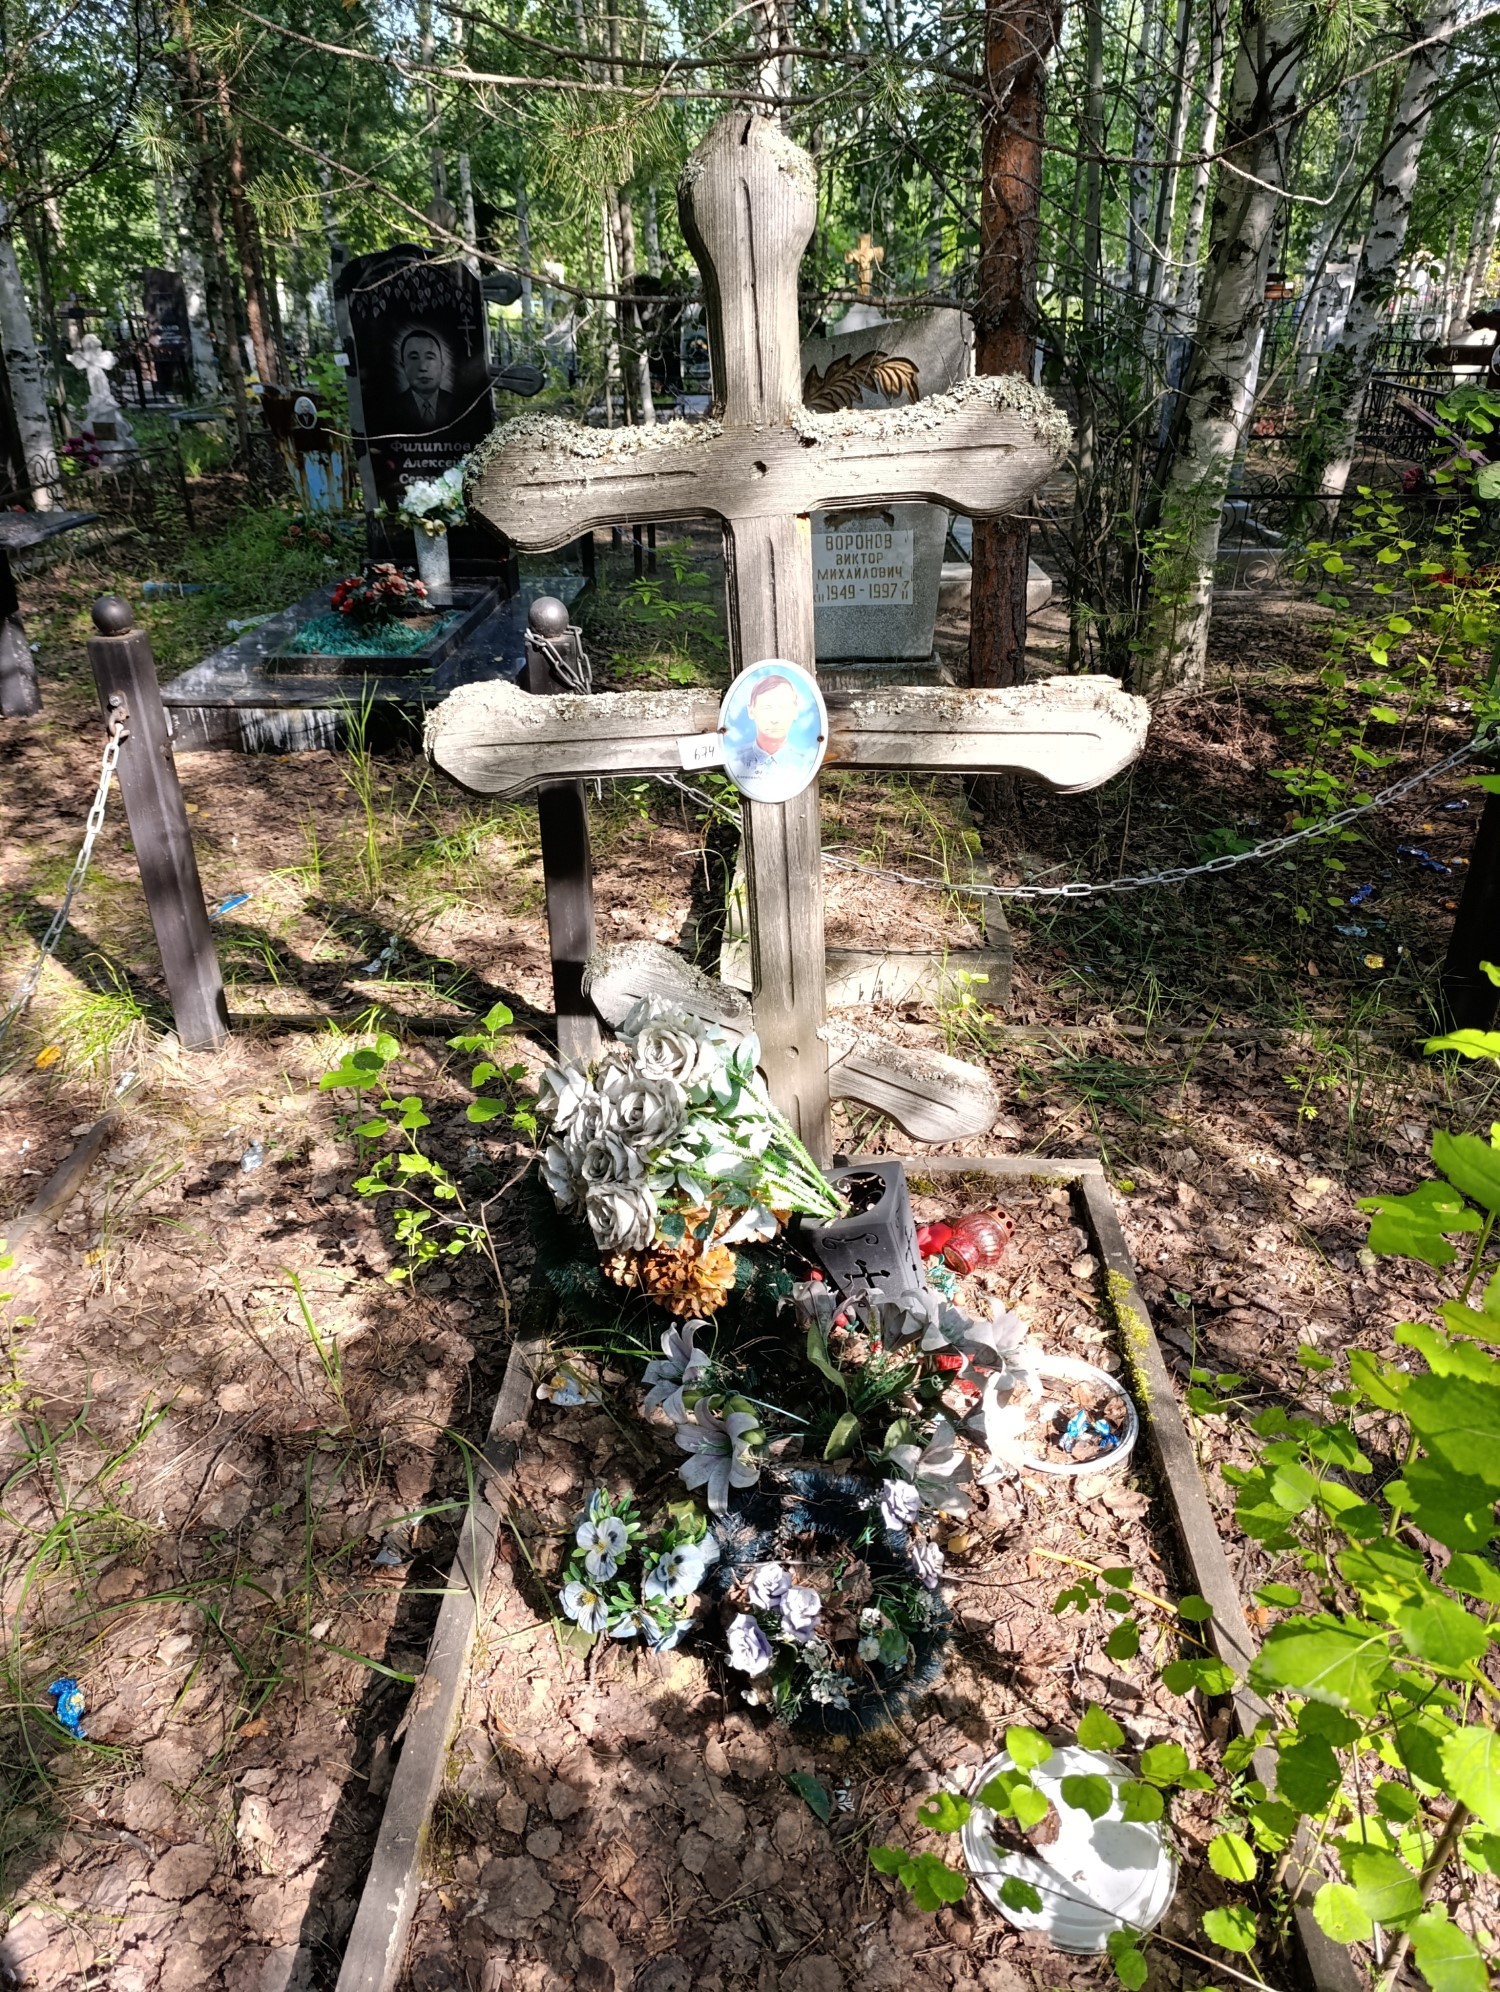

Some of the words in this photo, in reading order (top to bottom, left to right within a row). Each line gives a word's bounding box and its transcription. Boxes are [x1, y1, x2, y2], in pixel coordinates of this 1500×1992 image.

[390, 440, 471, 452] Филиппов
[825, 533, 892, 551] ВОРОНОВ
[836, 552, 883, 566] ВИКТОР
[827, 584, 855, 600] 1949
[869, 583, 898, 599] 1997
